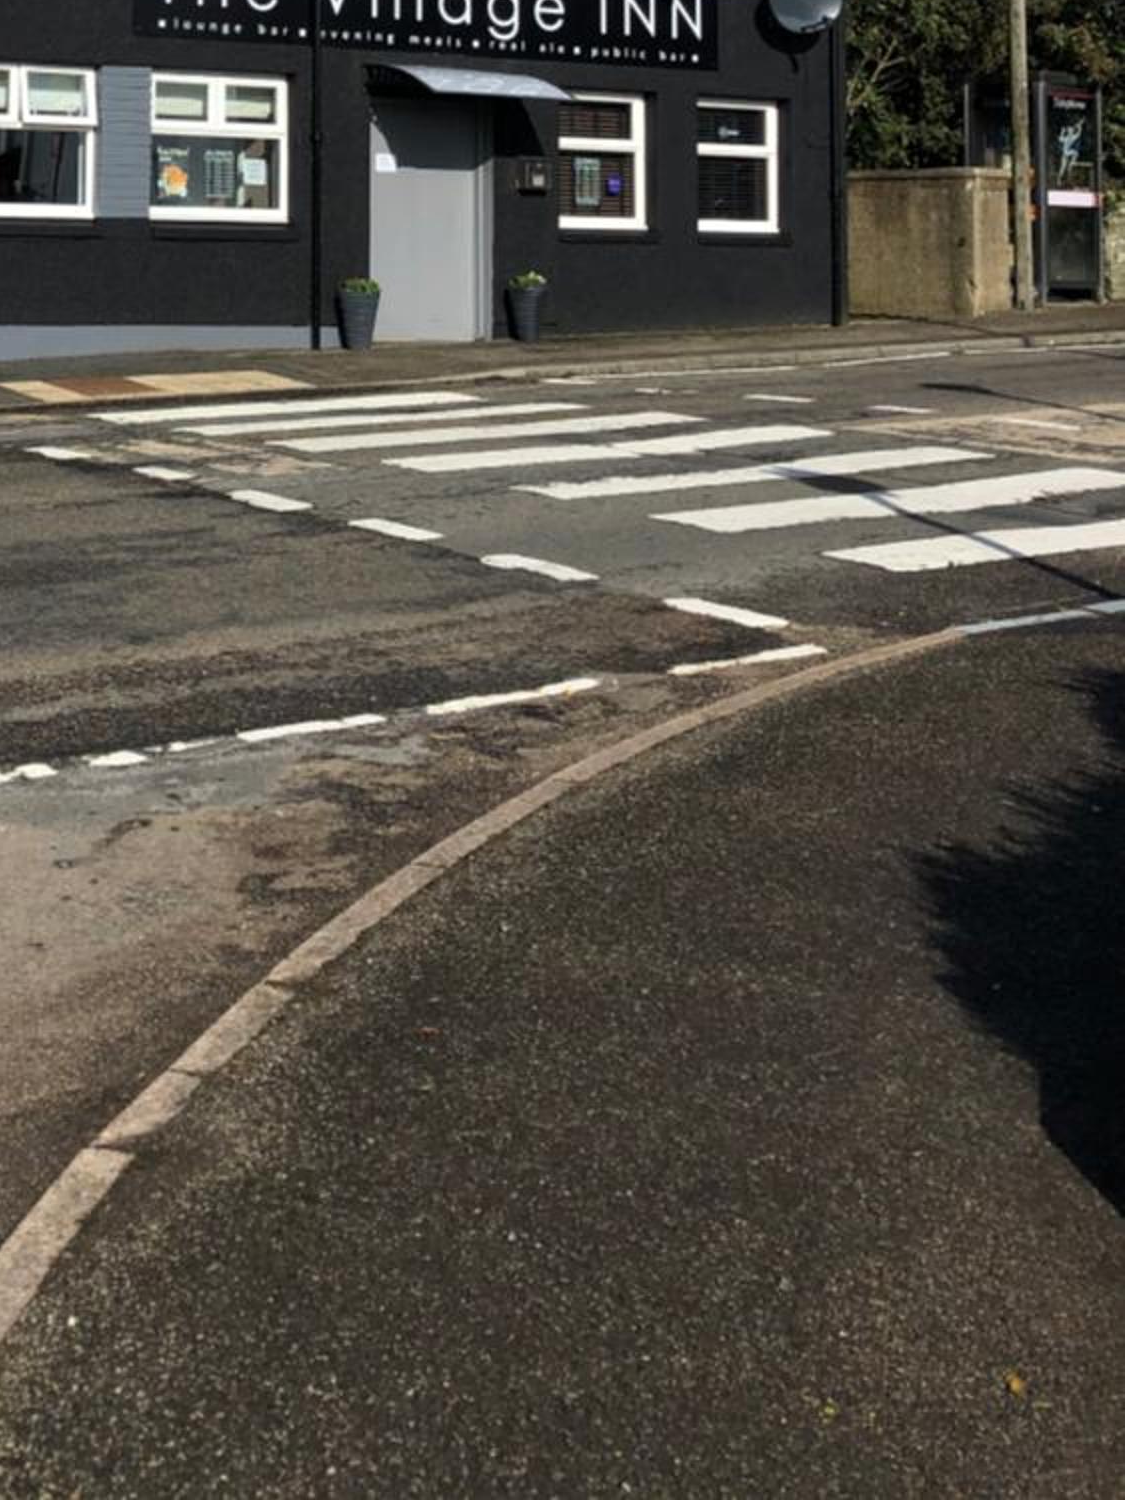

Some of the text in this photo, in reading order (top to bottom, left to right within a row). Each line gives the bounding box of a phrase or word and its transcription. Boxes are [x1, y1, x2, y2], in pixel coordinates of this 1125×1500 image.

[173, 17, 242, 35] lounge
[257, 23, 289, 36] bar
[408, 34, 463, 48] meals
[590, 47, 647, 60] public
[658, 50, 686, 62] bar
